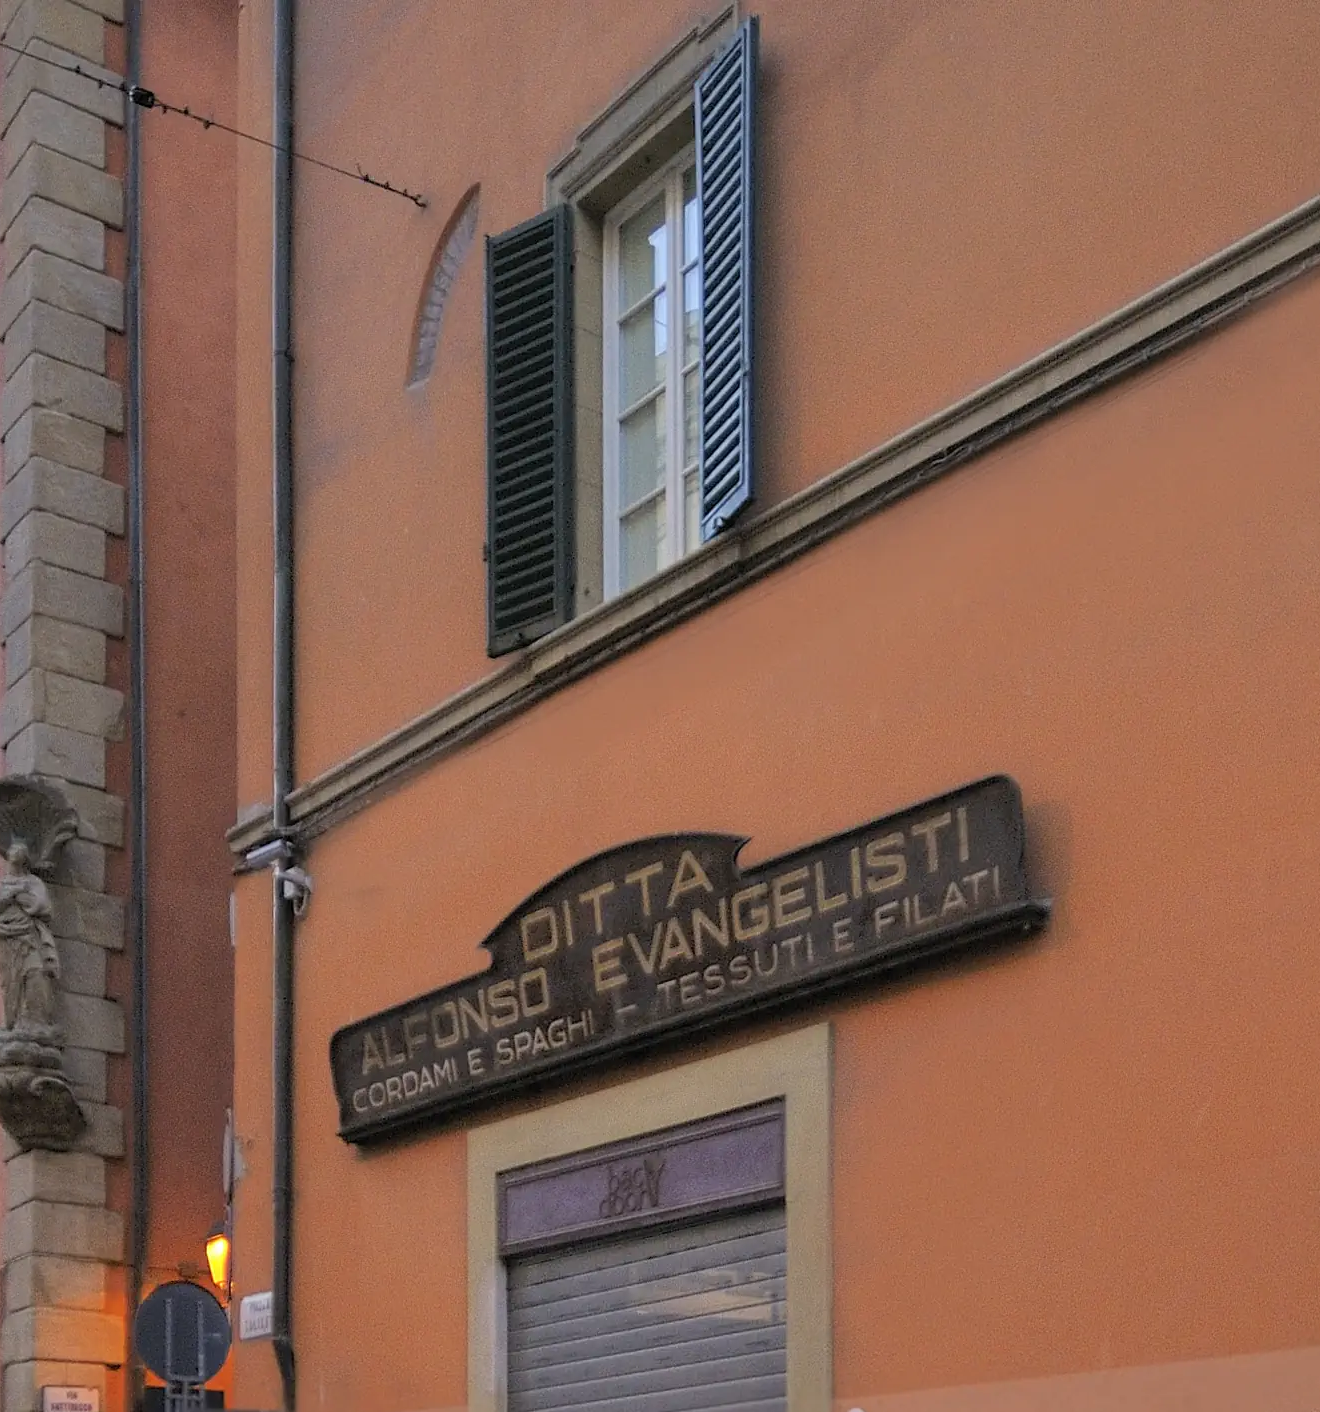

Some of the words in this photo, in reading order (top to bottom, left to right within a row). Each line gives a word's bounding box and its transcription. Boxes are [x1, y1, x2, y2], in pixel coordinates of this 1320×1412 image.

[352, 1056, 459, 1113] CORDAMI
[467, 1048, 486, 1076] E
[496, 1008, 595, 1066] SPAGHI
[656, 932, 814, 1007] TESSUTI
[832, 917, 855, 953] E
[874, 865, 1001, 939] FILATI
[361, 966, 550, 1076] ALFONSO
[591, 807, 970, 993] EVANGELISTI
[520, 849, 714, 963] DITTA
